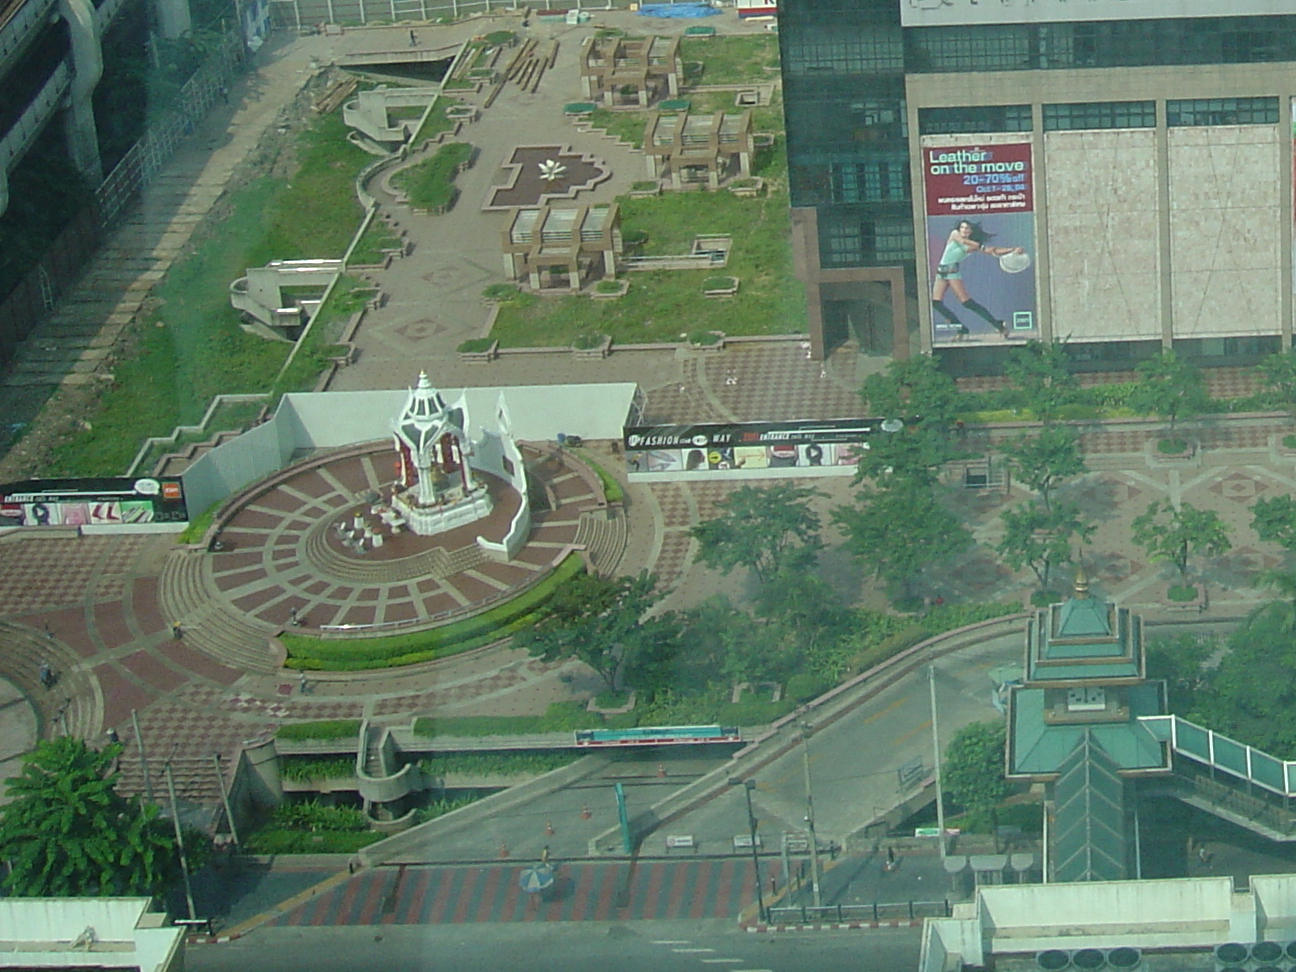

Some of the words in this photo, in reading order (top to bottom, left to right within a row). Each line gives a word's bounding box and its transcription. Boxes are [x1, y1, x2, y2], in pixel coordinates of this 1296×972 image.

[929, 149, 988, 163] Leather
[930, 164, 949, 175] on
[954, 162, 977, 174] the
[982, 161, 1025, 172] move
[639, 435, 680, 446] FASHION
[712, 434, 731, 443] WAY
